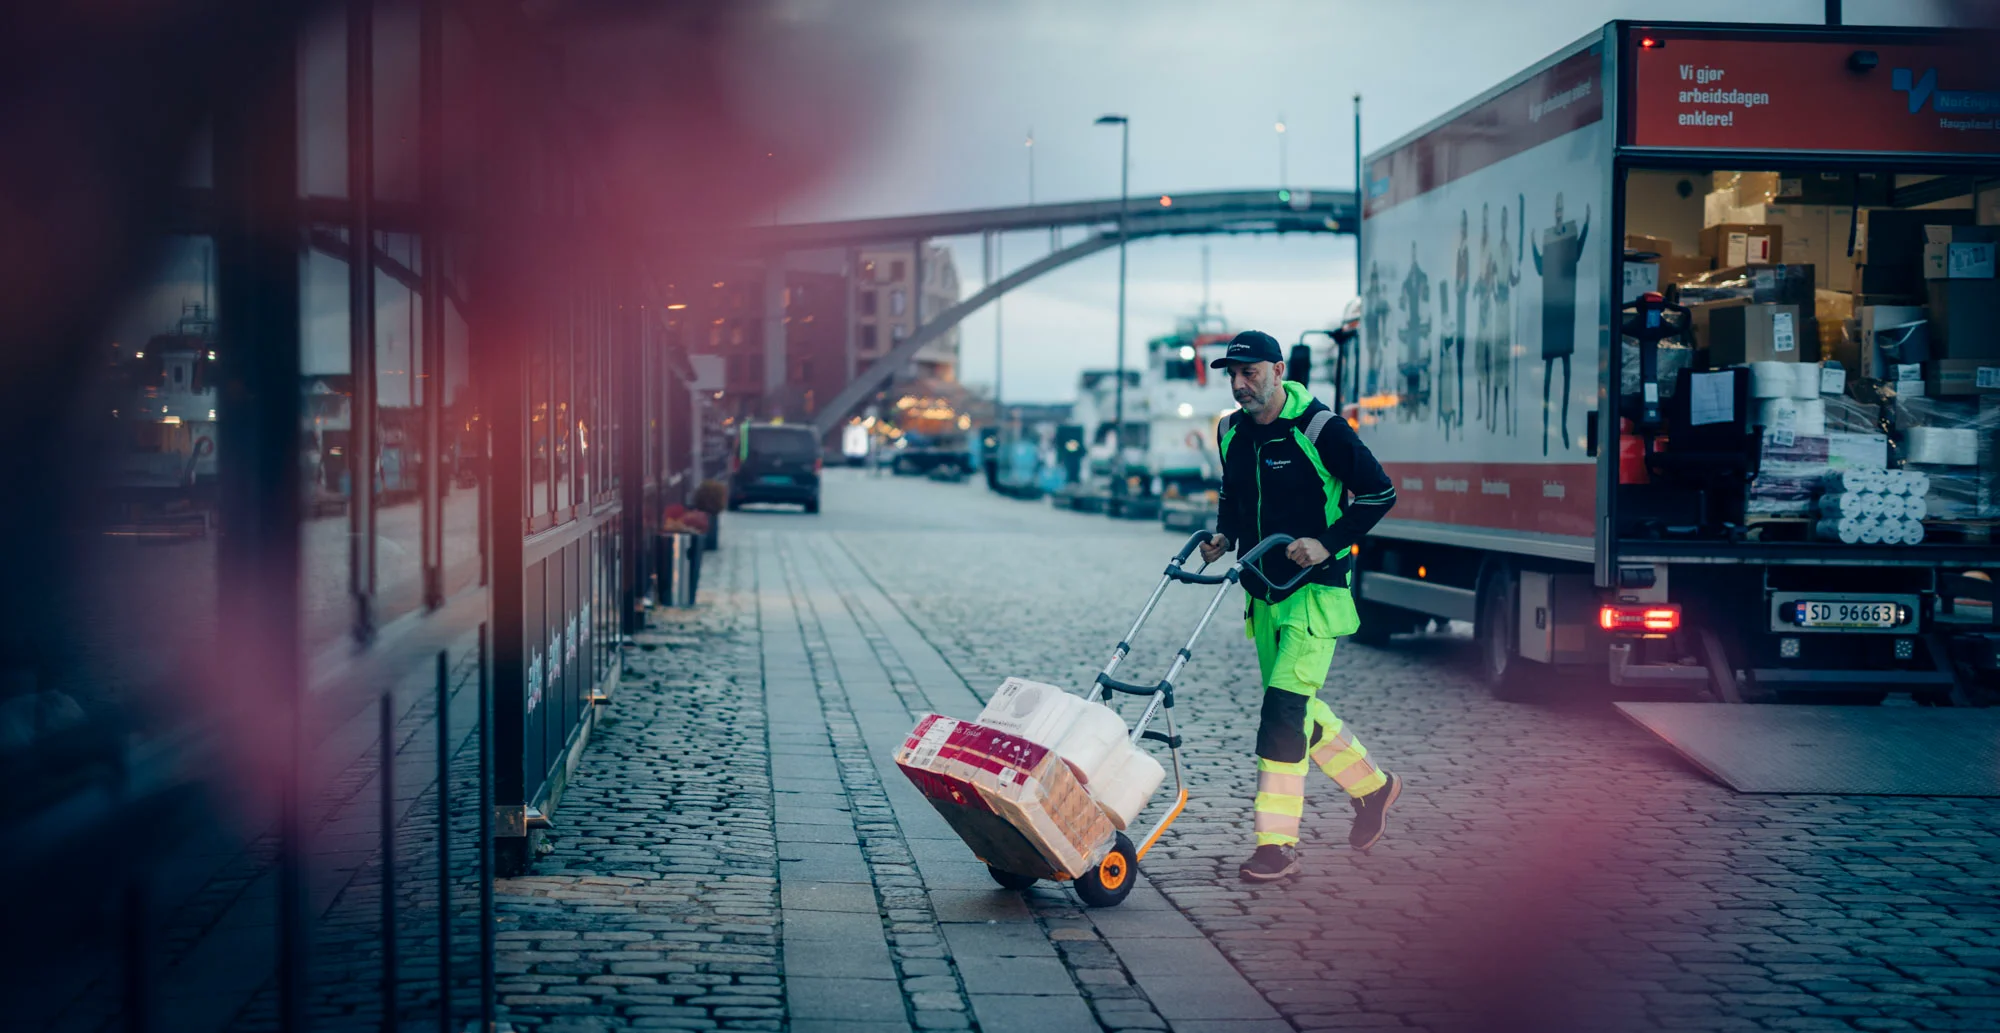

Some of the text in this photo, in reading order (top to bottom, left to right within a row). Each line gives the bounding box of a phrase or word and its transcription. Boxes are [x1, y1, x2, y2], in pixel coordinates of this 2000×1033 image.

[1679, 65, 1725, 84] Vi gjør
[1678, 89, 1770, 107] arbeidsdagen
[1678, 111, 1734, 127] enklere!
[1811, 604, 1891, 621] SD 96663
